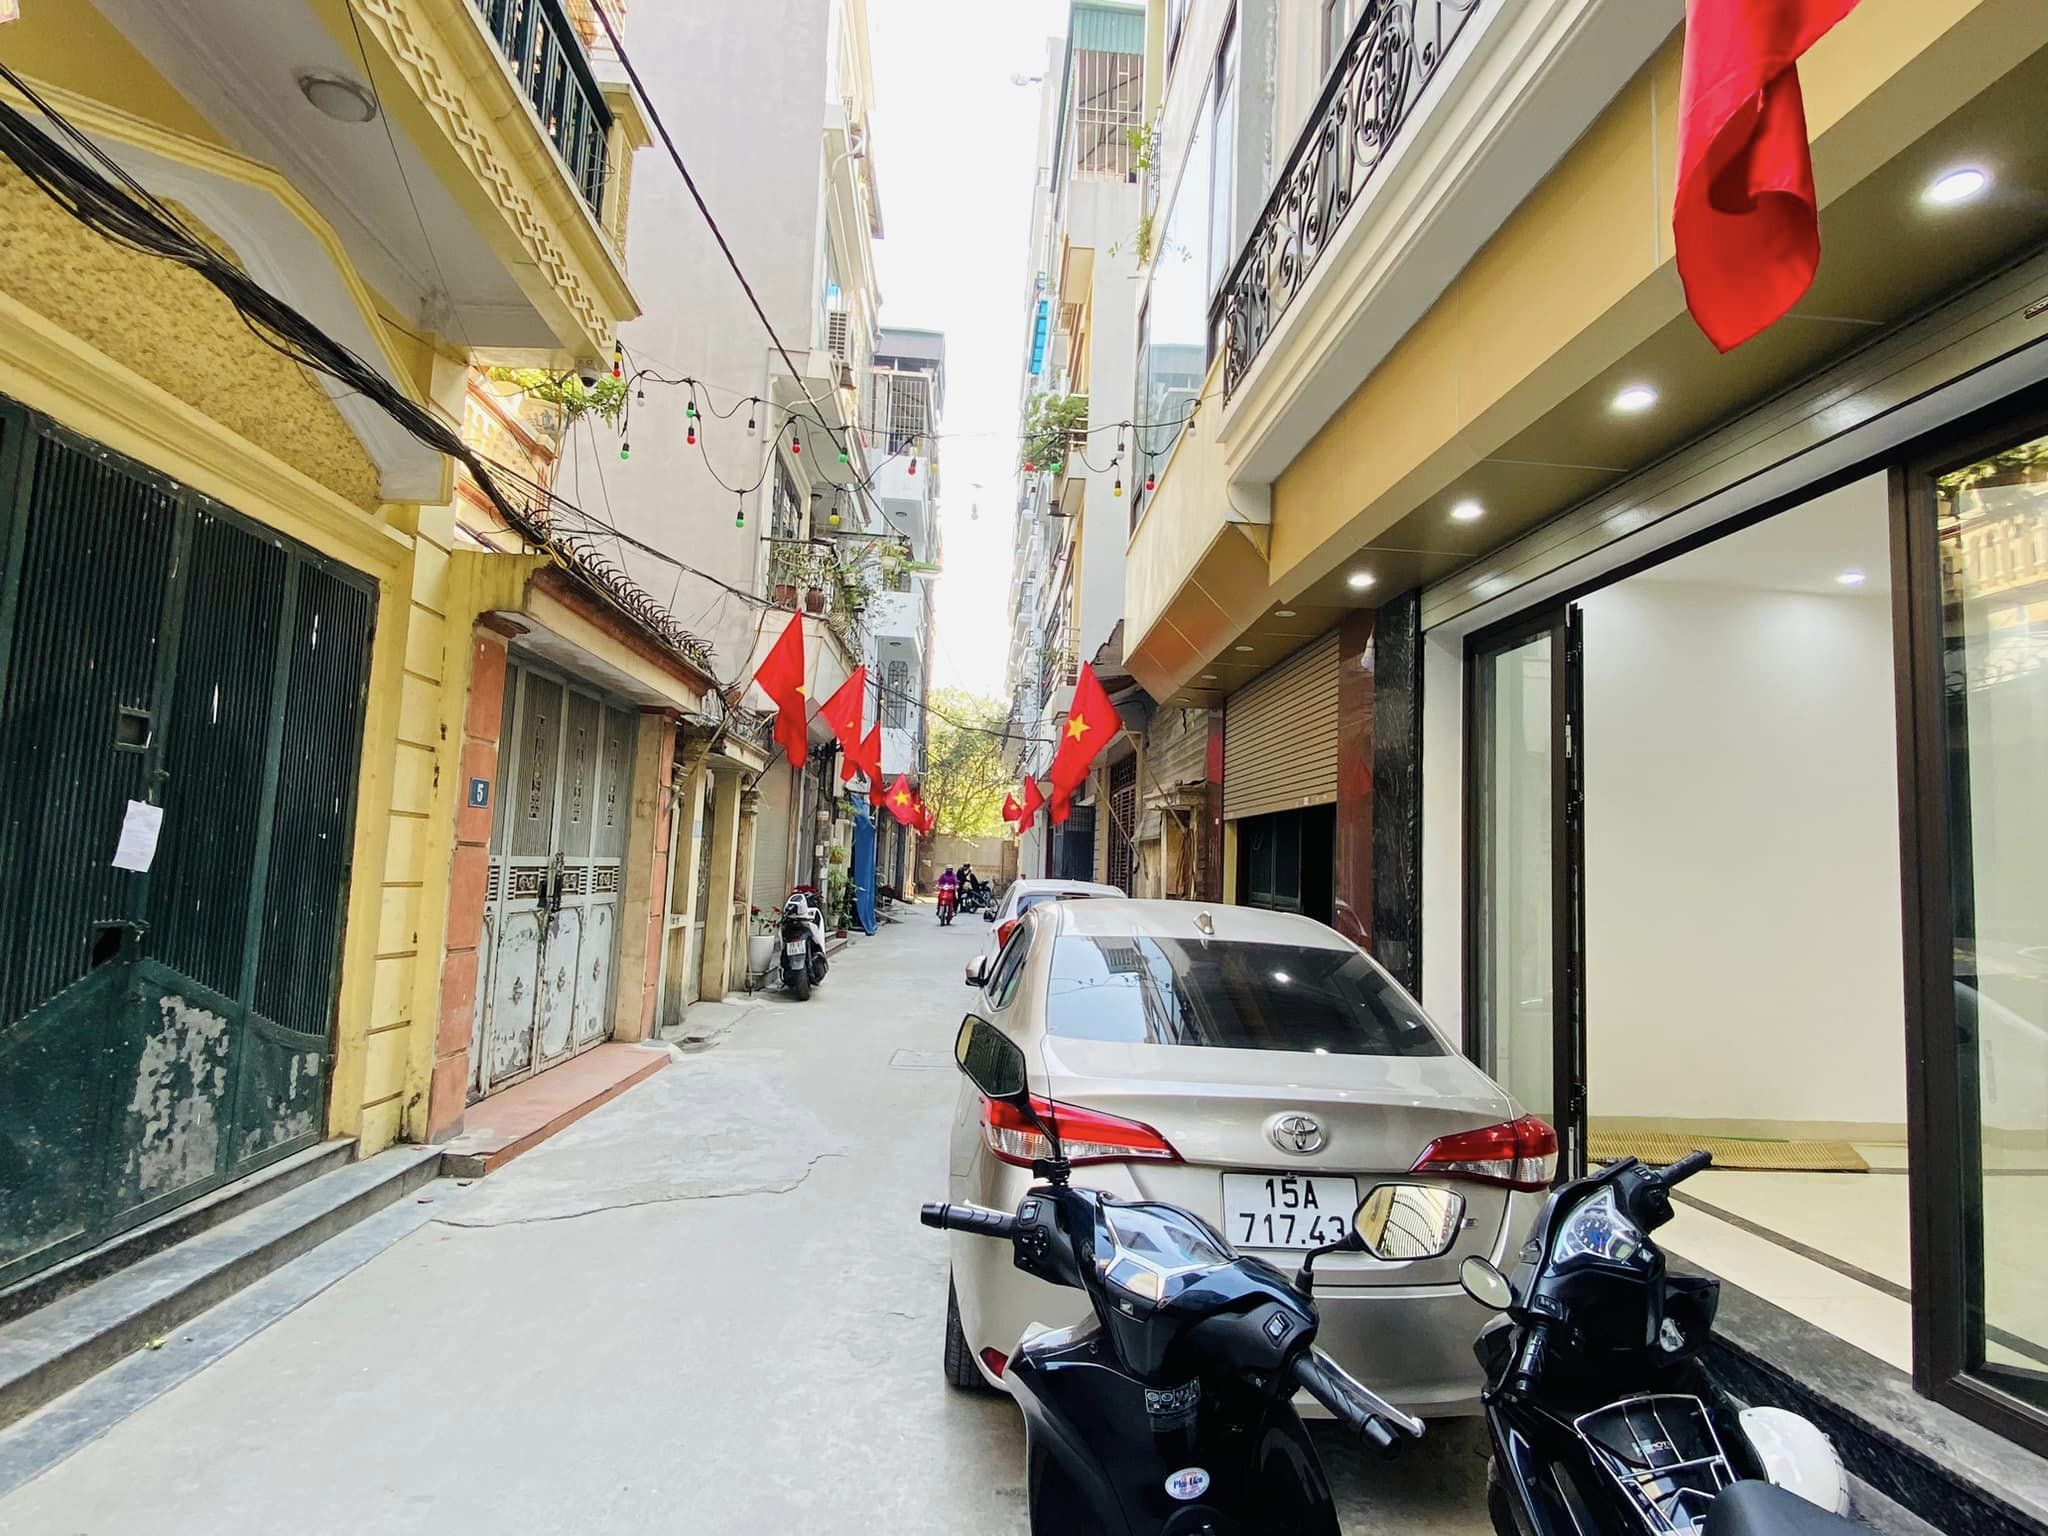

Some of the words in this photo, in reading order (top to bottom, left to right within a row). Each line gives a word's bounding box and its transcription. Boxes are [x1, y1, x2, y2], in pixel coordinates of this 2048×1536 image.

[477, 783, 484, 802] 5
[1265, 1178, 1319, 1210] 15A
[1239, 1213, 1346, 1245] 717.43
